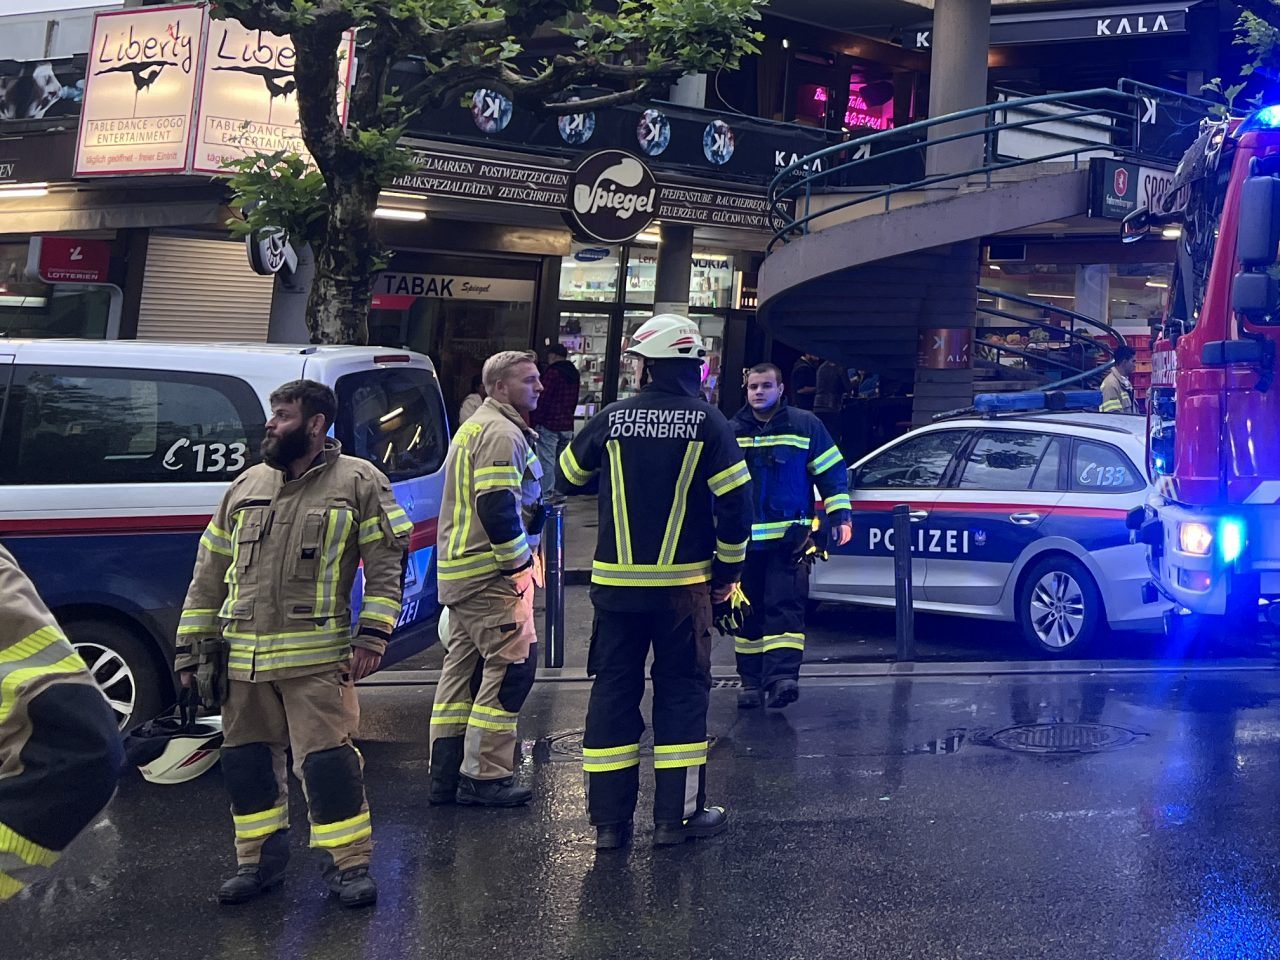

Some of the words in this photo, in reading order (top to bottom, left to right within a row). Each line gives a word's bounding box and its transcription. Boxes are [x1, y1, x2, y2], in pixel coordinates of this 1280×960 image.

[1097, 15, 1169, 36] KALA
[99, 19, 192, 74] Liberty
[217, 28, 297, 68] Libe
[89, 120, 115, 132] TABLE
[117, 119, 147, 131] DANCE
[157, 117, 183, 129] GOGO
[248, 125, 288, 138] DANCE
[97, 130, 171, 144] ENTERTAINMENT
[479, 164, 570, 185] POSTWERTZEICHEN
[498, 186, 568, 204] ZEITSCHRIFTEN
[659, 187, 713, 204] PFEIFENSTUBE
[658, 204, 709, 221] FEUERZEUGE
[47, 271, 99, 281] LOTTERIEN
[383, 274, 455, 297] TABAK
[461, 281, 492, 295] Spiegel
[608, 408, 707, 428] FEUERWEHR
[610, 423, 699, 440] DORNBIRN
[192, 442, 246, 473] 133
[1095, 465, 1126, 487] 133
[868, 527, 970, 554] POIZEI
